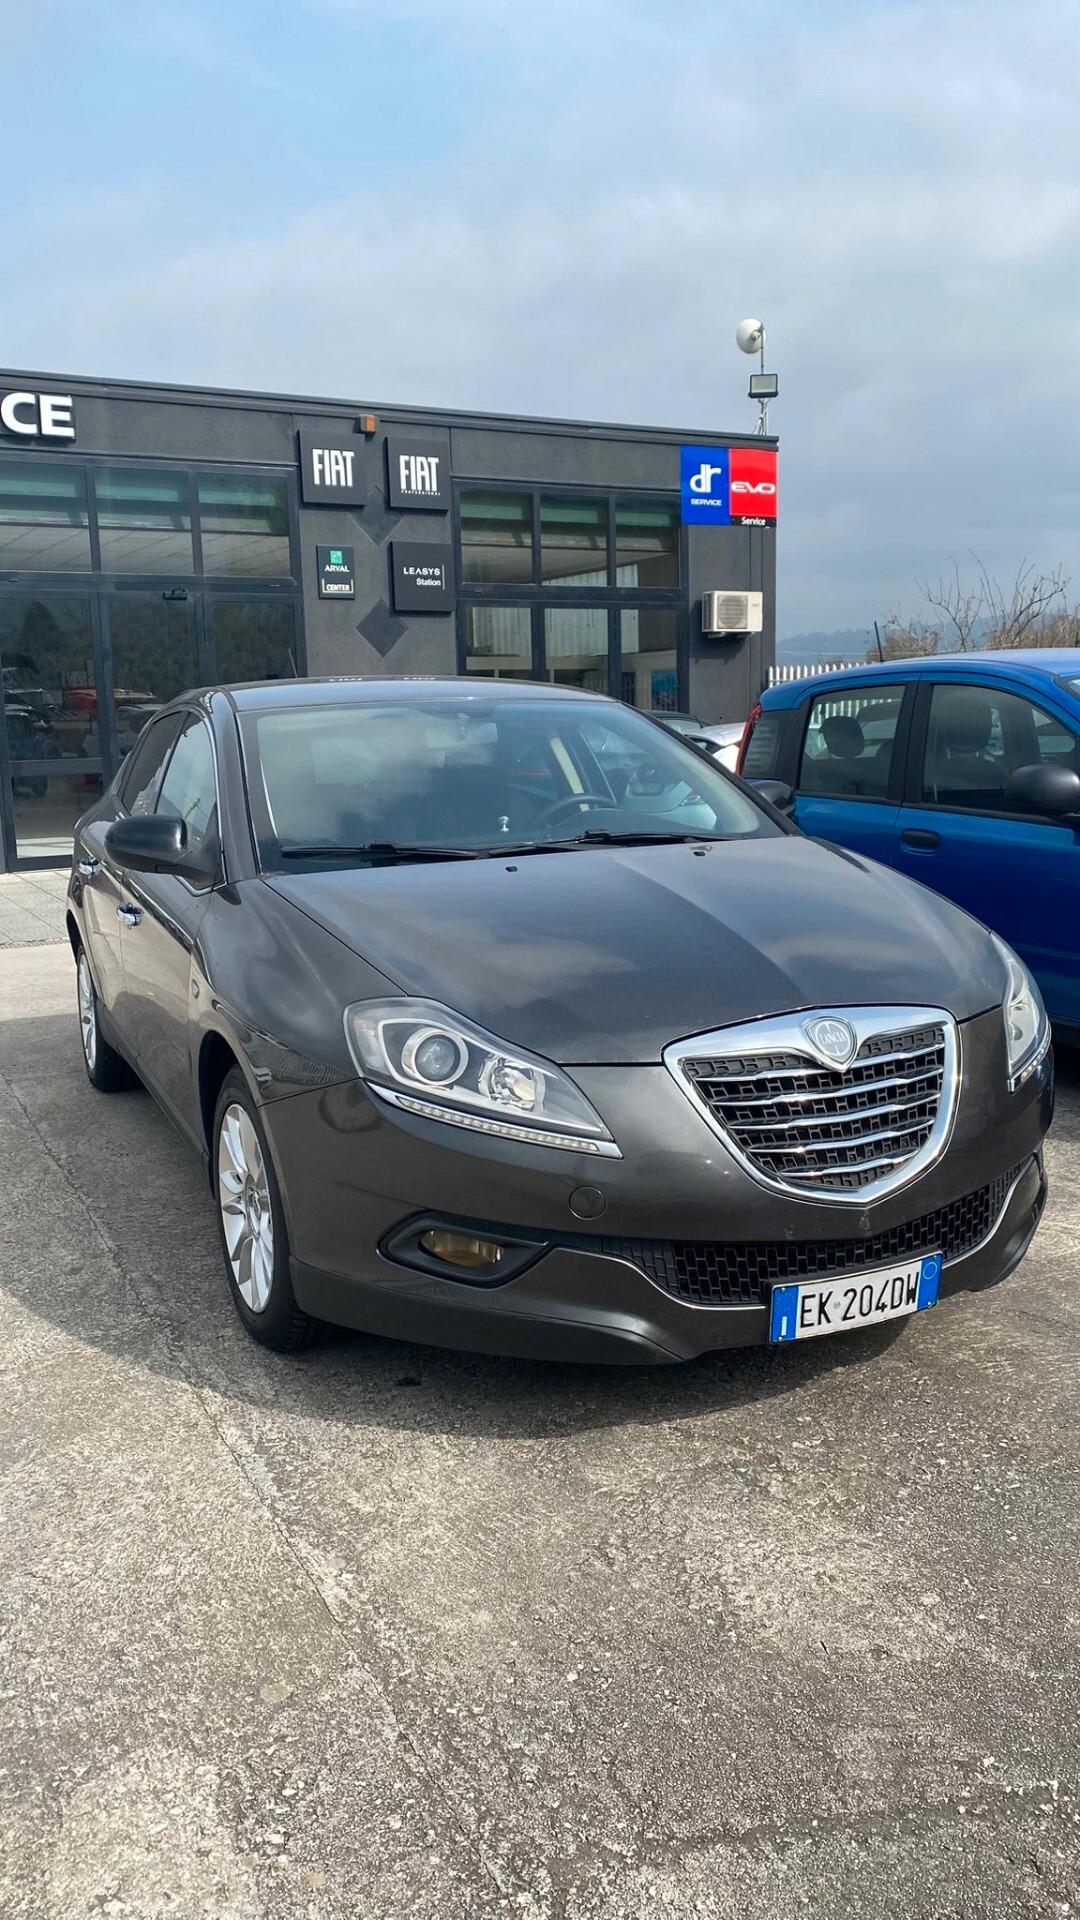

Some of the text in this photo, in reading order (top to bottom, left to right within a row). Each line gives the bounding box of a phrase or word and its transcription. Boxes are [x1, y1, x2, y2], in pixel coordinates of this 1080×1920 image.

[0, 392, 75, 437] CE
[312, 448, 355, 487] FIAT
[399, 454, 439, 491] FIAT
[689, 463, 722, 493] dr
[730, 481, 776, 494] EVO
[690, 498, 722, 506] SERVICE
[741, 516, 766, 526] Service
[324, 564, 350, 572] ARVAL
[403, 566, 441, 576] LEASYS
[326, 583, 350, 591] CENTER
[415, 577, 442, 586] Station
[799, 1290, 834, 1329] EK
[841, 1271, 920, 1322] 204DW
